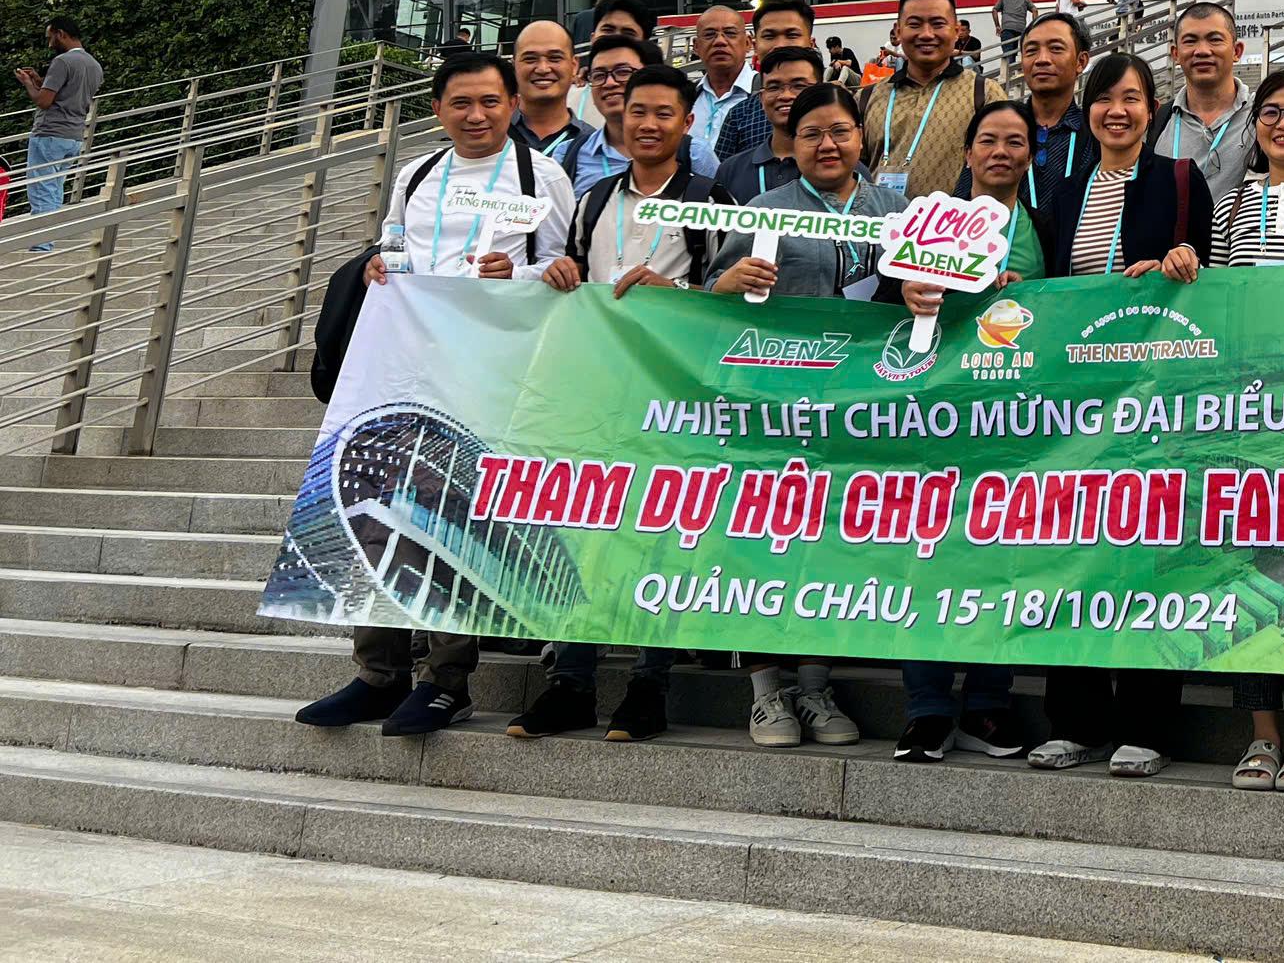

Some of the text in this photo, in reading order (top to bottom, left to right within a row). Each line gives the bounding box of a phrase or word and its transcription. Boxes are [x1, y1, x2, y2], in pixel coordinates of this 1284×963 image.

[961, 351, 1034, 368] LONG AN
[1066, 339, 1218, 363] THE NEW TRAVEL
[759, 358, 803, 367] TRAVEL
[908, 360, 934, 378] TOUR
[973, 369, 1021, 380] TRAVEL
[641, 396, 752, 446] NHIỆT
[761, 397, 835, 446] LIỆT
[844, 394, 959, 438] CHÀO
[970, 392, 1104, 437] MỪNG
[1112, 394, 1185, 444] ĐẠI
[470, 453, 636, 530] THAM
[635, 464, 733, 549] DỰ
[726, 457, 832, 554] HỘI
[839, 466, 960, 558] CHỢ
[965, 468, 1187, 546] CANTON
[634, 566, 1238, 631] QUẢNG CHÂU, 15-18/10/2024
